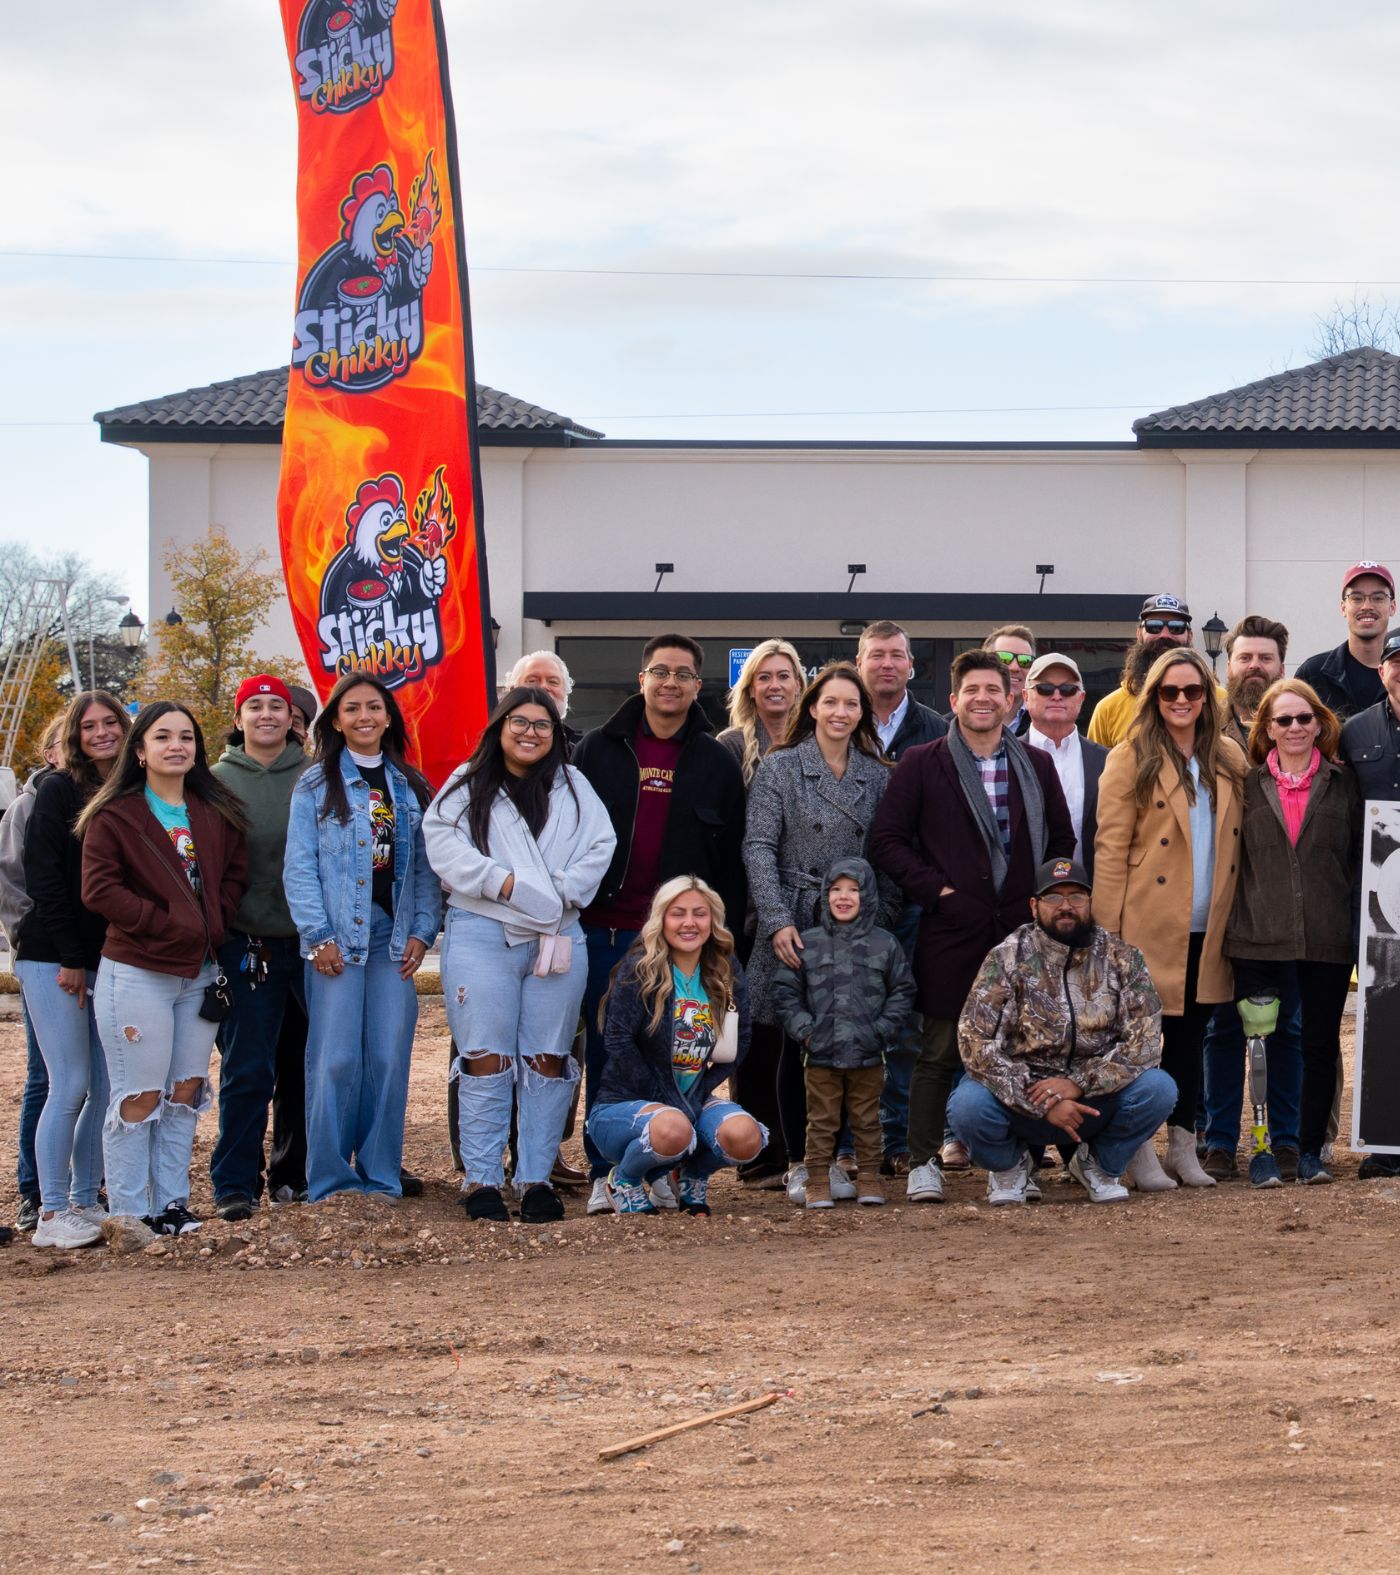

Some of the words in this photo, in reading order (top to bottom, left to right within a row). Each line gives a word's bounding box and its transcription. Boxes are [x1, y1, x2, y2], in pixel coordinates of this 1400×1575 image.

[296, 26, 392, 97] Sticky
[312, 62, 383, 112] Chikky
[293, 295, 420, 364] Sticky
[305, 335, 408, 385] Chikky
[318, 601, 438, 667] Sticky
[336, 639, 423, 678] Chikky
[661, 769, 674, 783] CAR
[673, 1040, 711, 1062] icky
